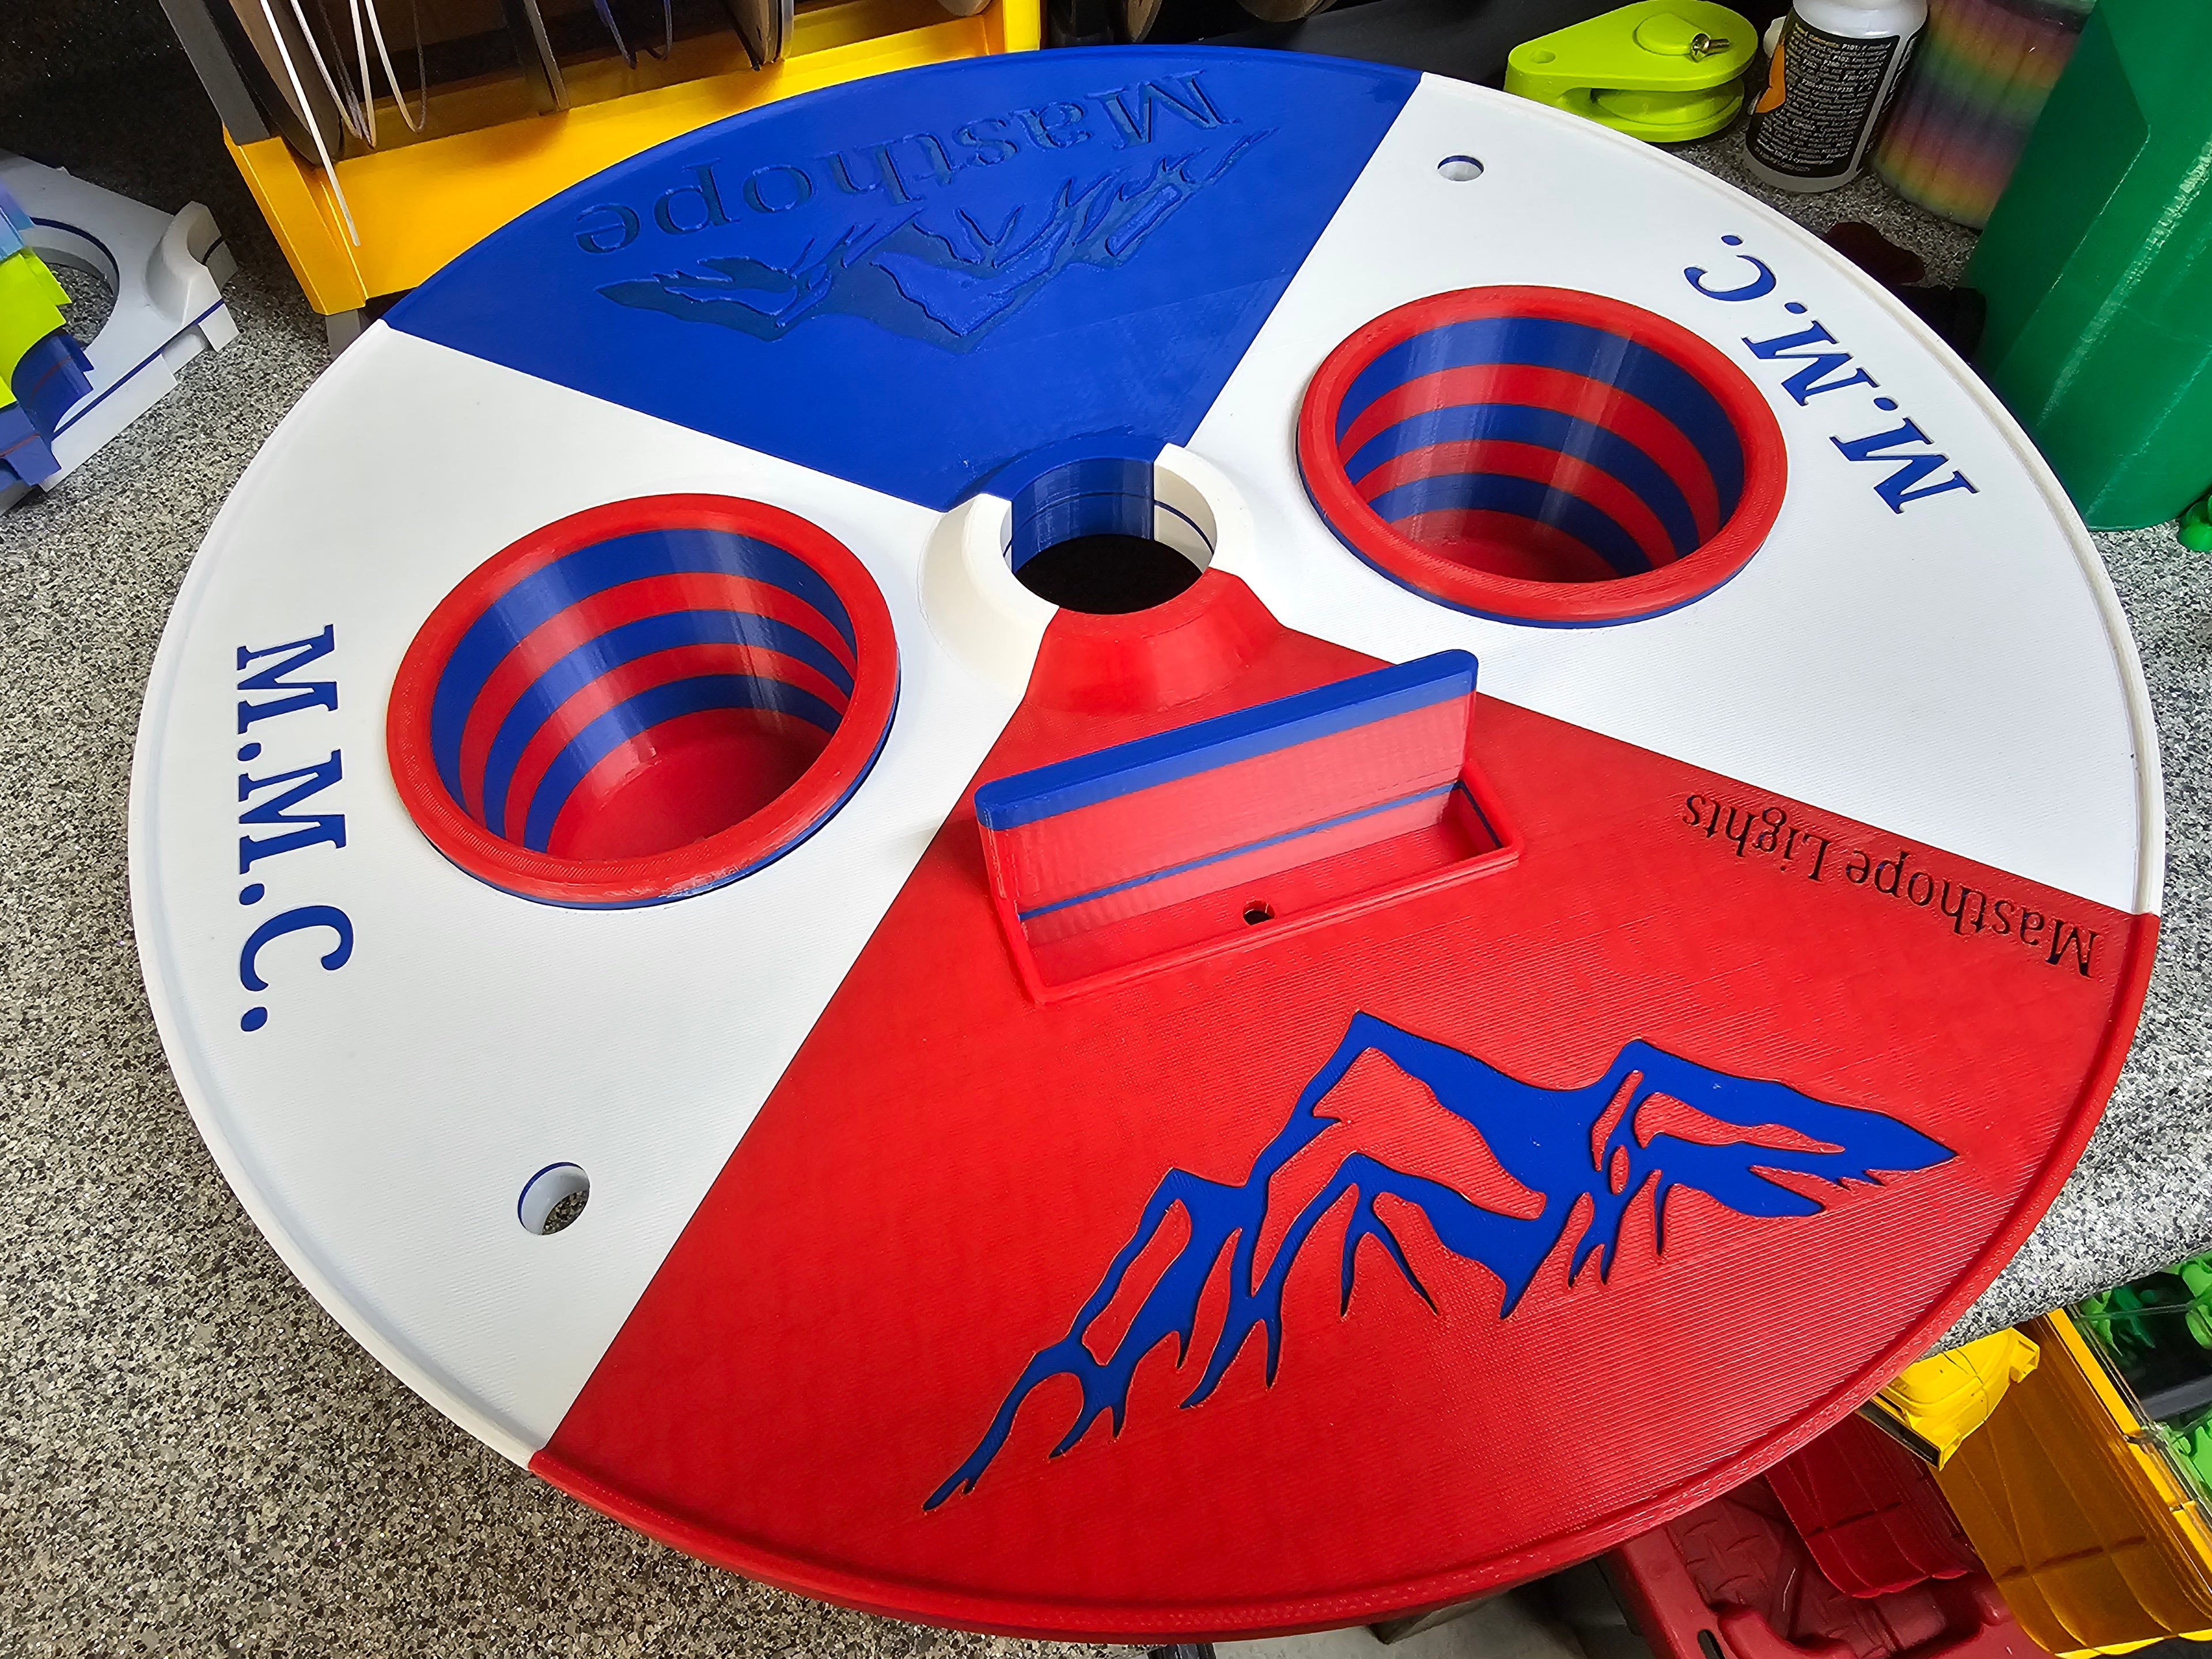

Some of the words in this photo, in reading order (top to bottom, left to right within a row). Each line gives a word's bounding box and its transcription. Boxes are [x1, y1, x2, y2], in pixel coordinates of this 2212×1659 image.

[575, 69, 1237, 255] Masthope
[1683, 233, 1981, 514] M.M.C.
[237, 623, 354, 1032] M.M.C.
[1682, 793, 1832, 883] Lights
[1844, 849, 2100, 979] Masthope
